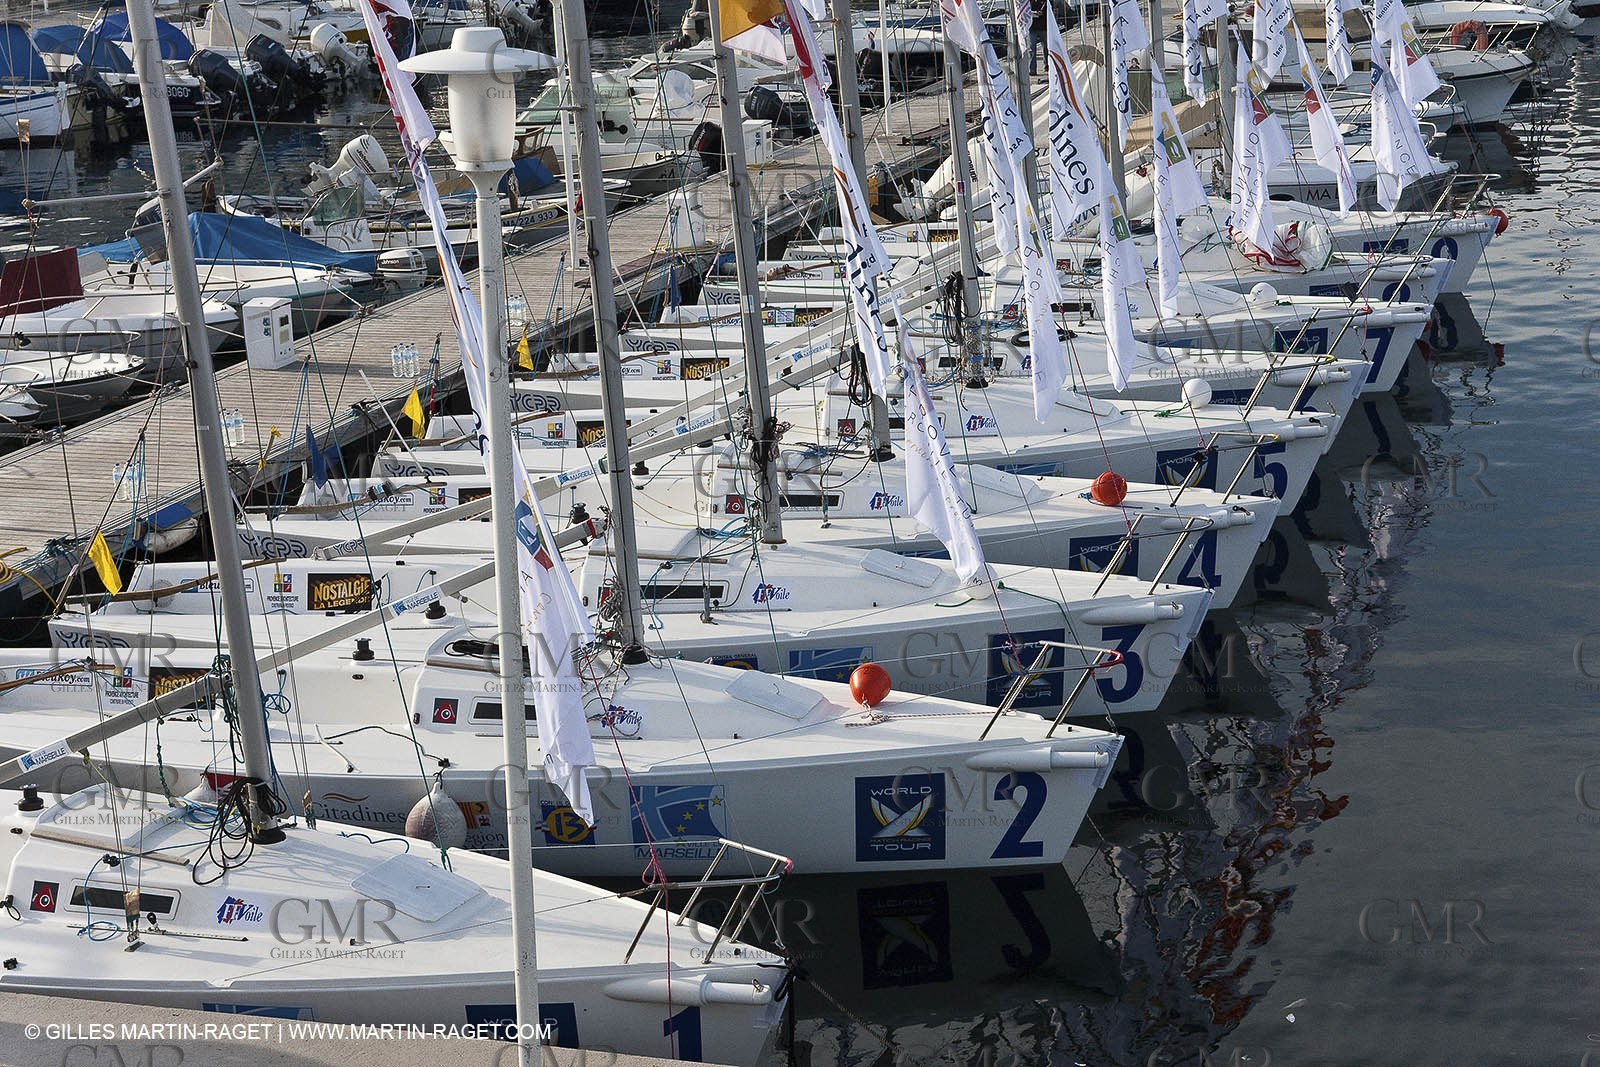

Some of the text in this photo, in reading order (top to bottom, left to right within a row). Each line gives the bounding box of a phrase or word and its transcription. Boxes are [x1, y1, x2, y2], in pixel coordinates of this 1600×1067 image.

[519, 215, 536, 226] 224
[538, 210, 554, 221] 933
[1307, 188, 1322, 201] MA
[1364, 327, 1396, 384] 7
[1253, 441, 1288, 500] 5
[1177, 529, 1222, 588] 4
[1096, 624, 1144, 704] 3
[870, 786, 932, 796] WORLD
[990, 771, 1048, 859] 2
[555, 812, 585, 839] 13
[870, 842, 932, 851] TOUR
[663, 1005, 702, 1062] 1
